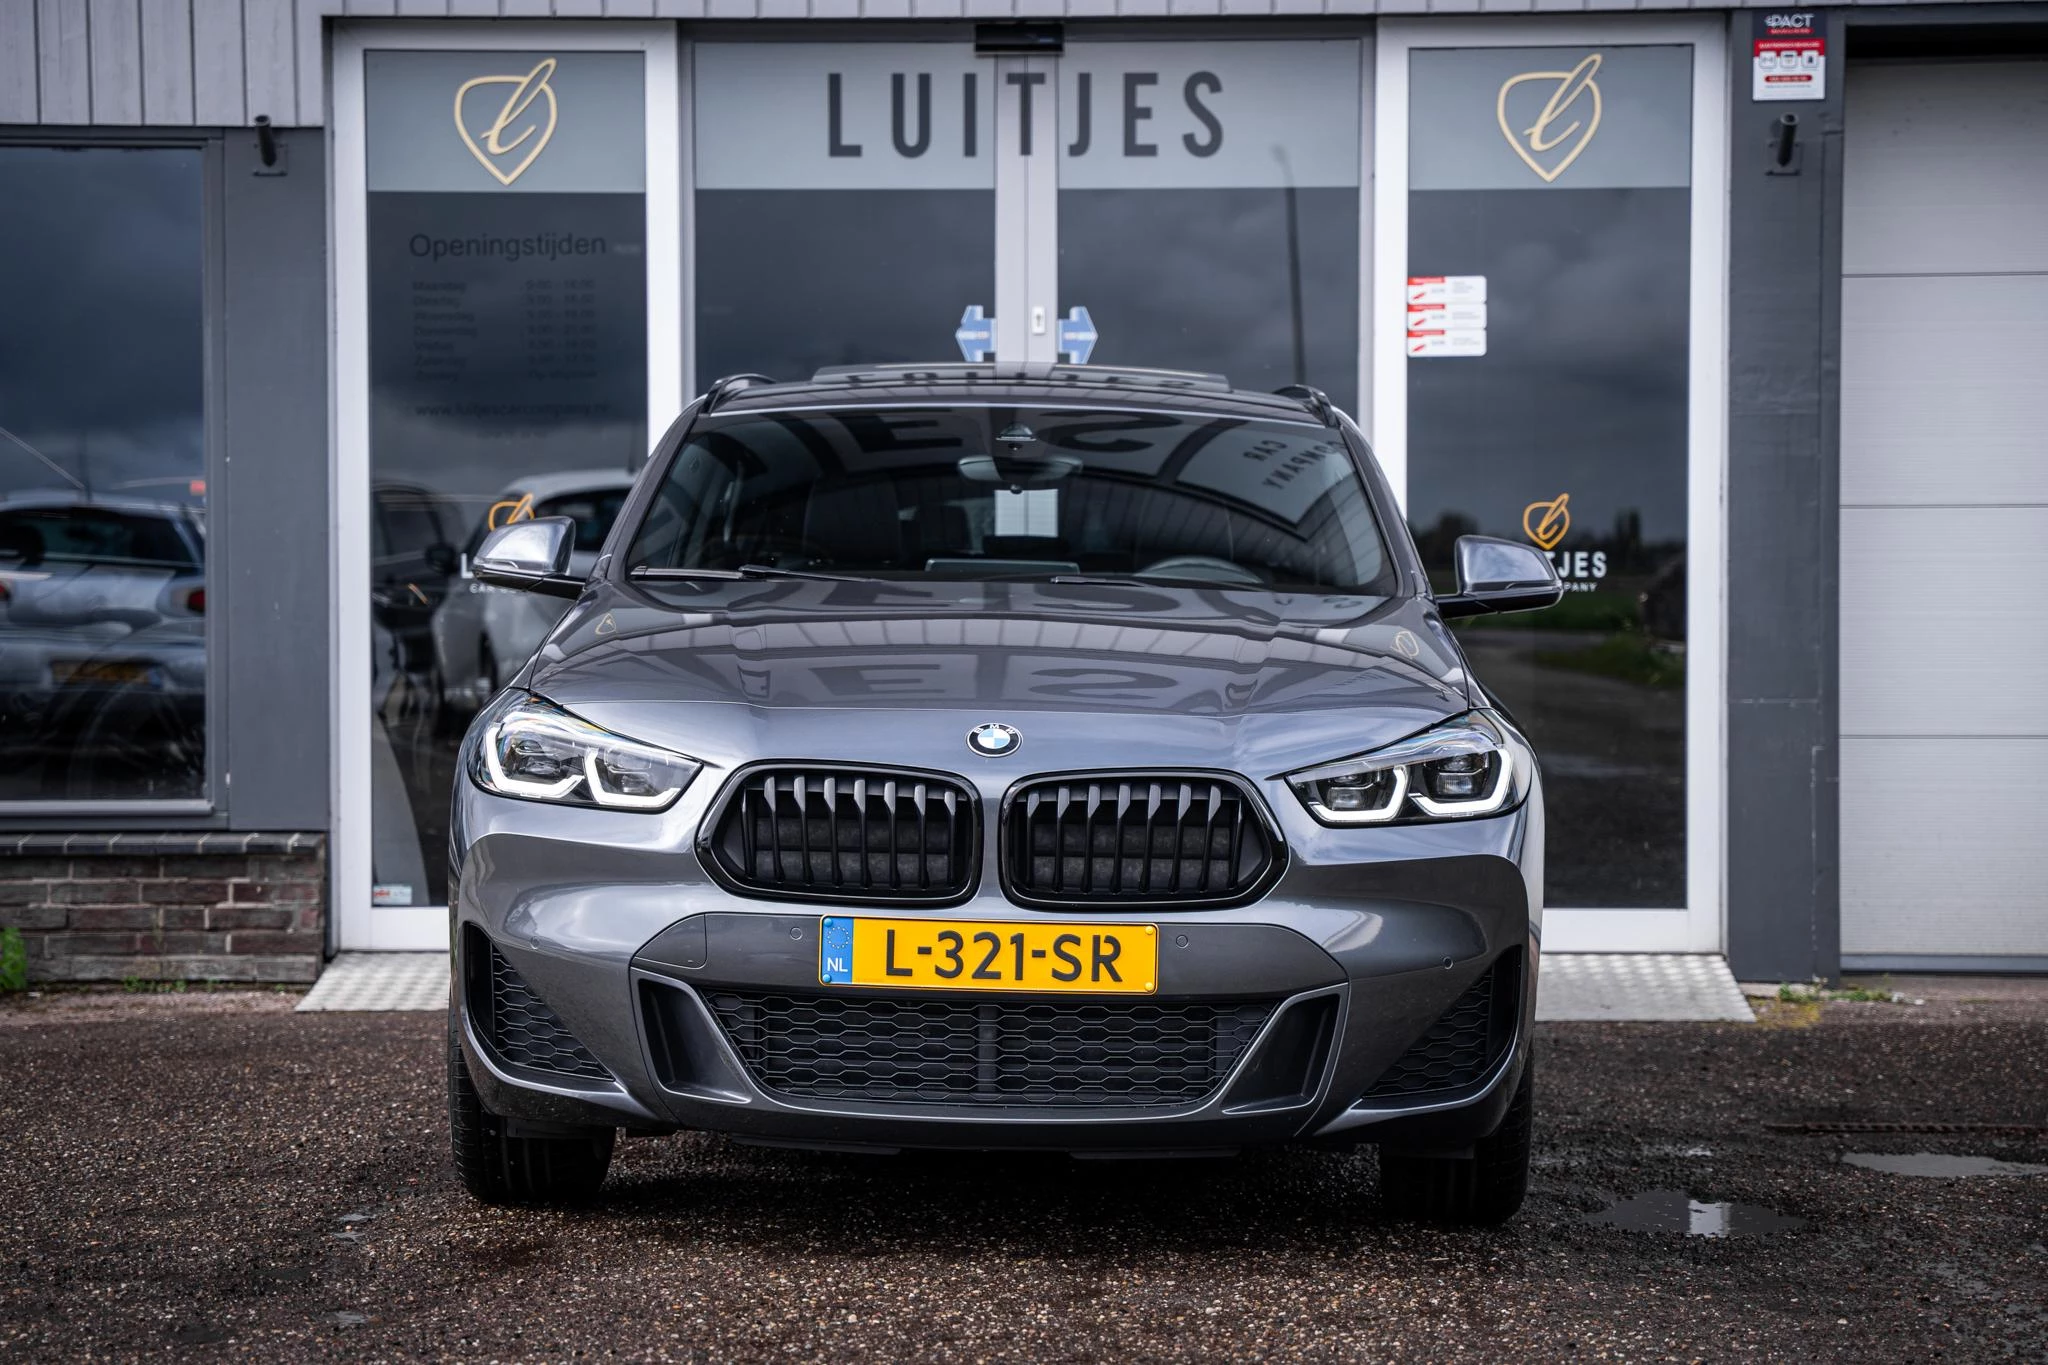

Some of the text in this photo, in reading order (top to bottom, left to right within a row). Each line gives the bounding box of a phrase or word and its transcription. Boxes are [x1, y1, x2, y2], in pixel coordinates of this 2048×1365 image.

[828, 71, 1223, 158] LUITJES
[409, 232, 606, 262] Openingstijden
[1563, 582, 1597, 592] PANY
[973, 724, 1016, 735] BMW
[827, 957, 848, 973] NL
[885, 929, 1123, 983] L-321-SR
